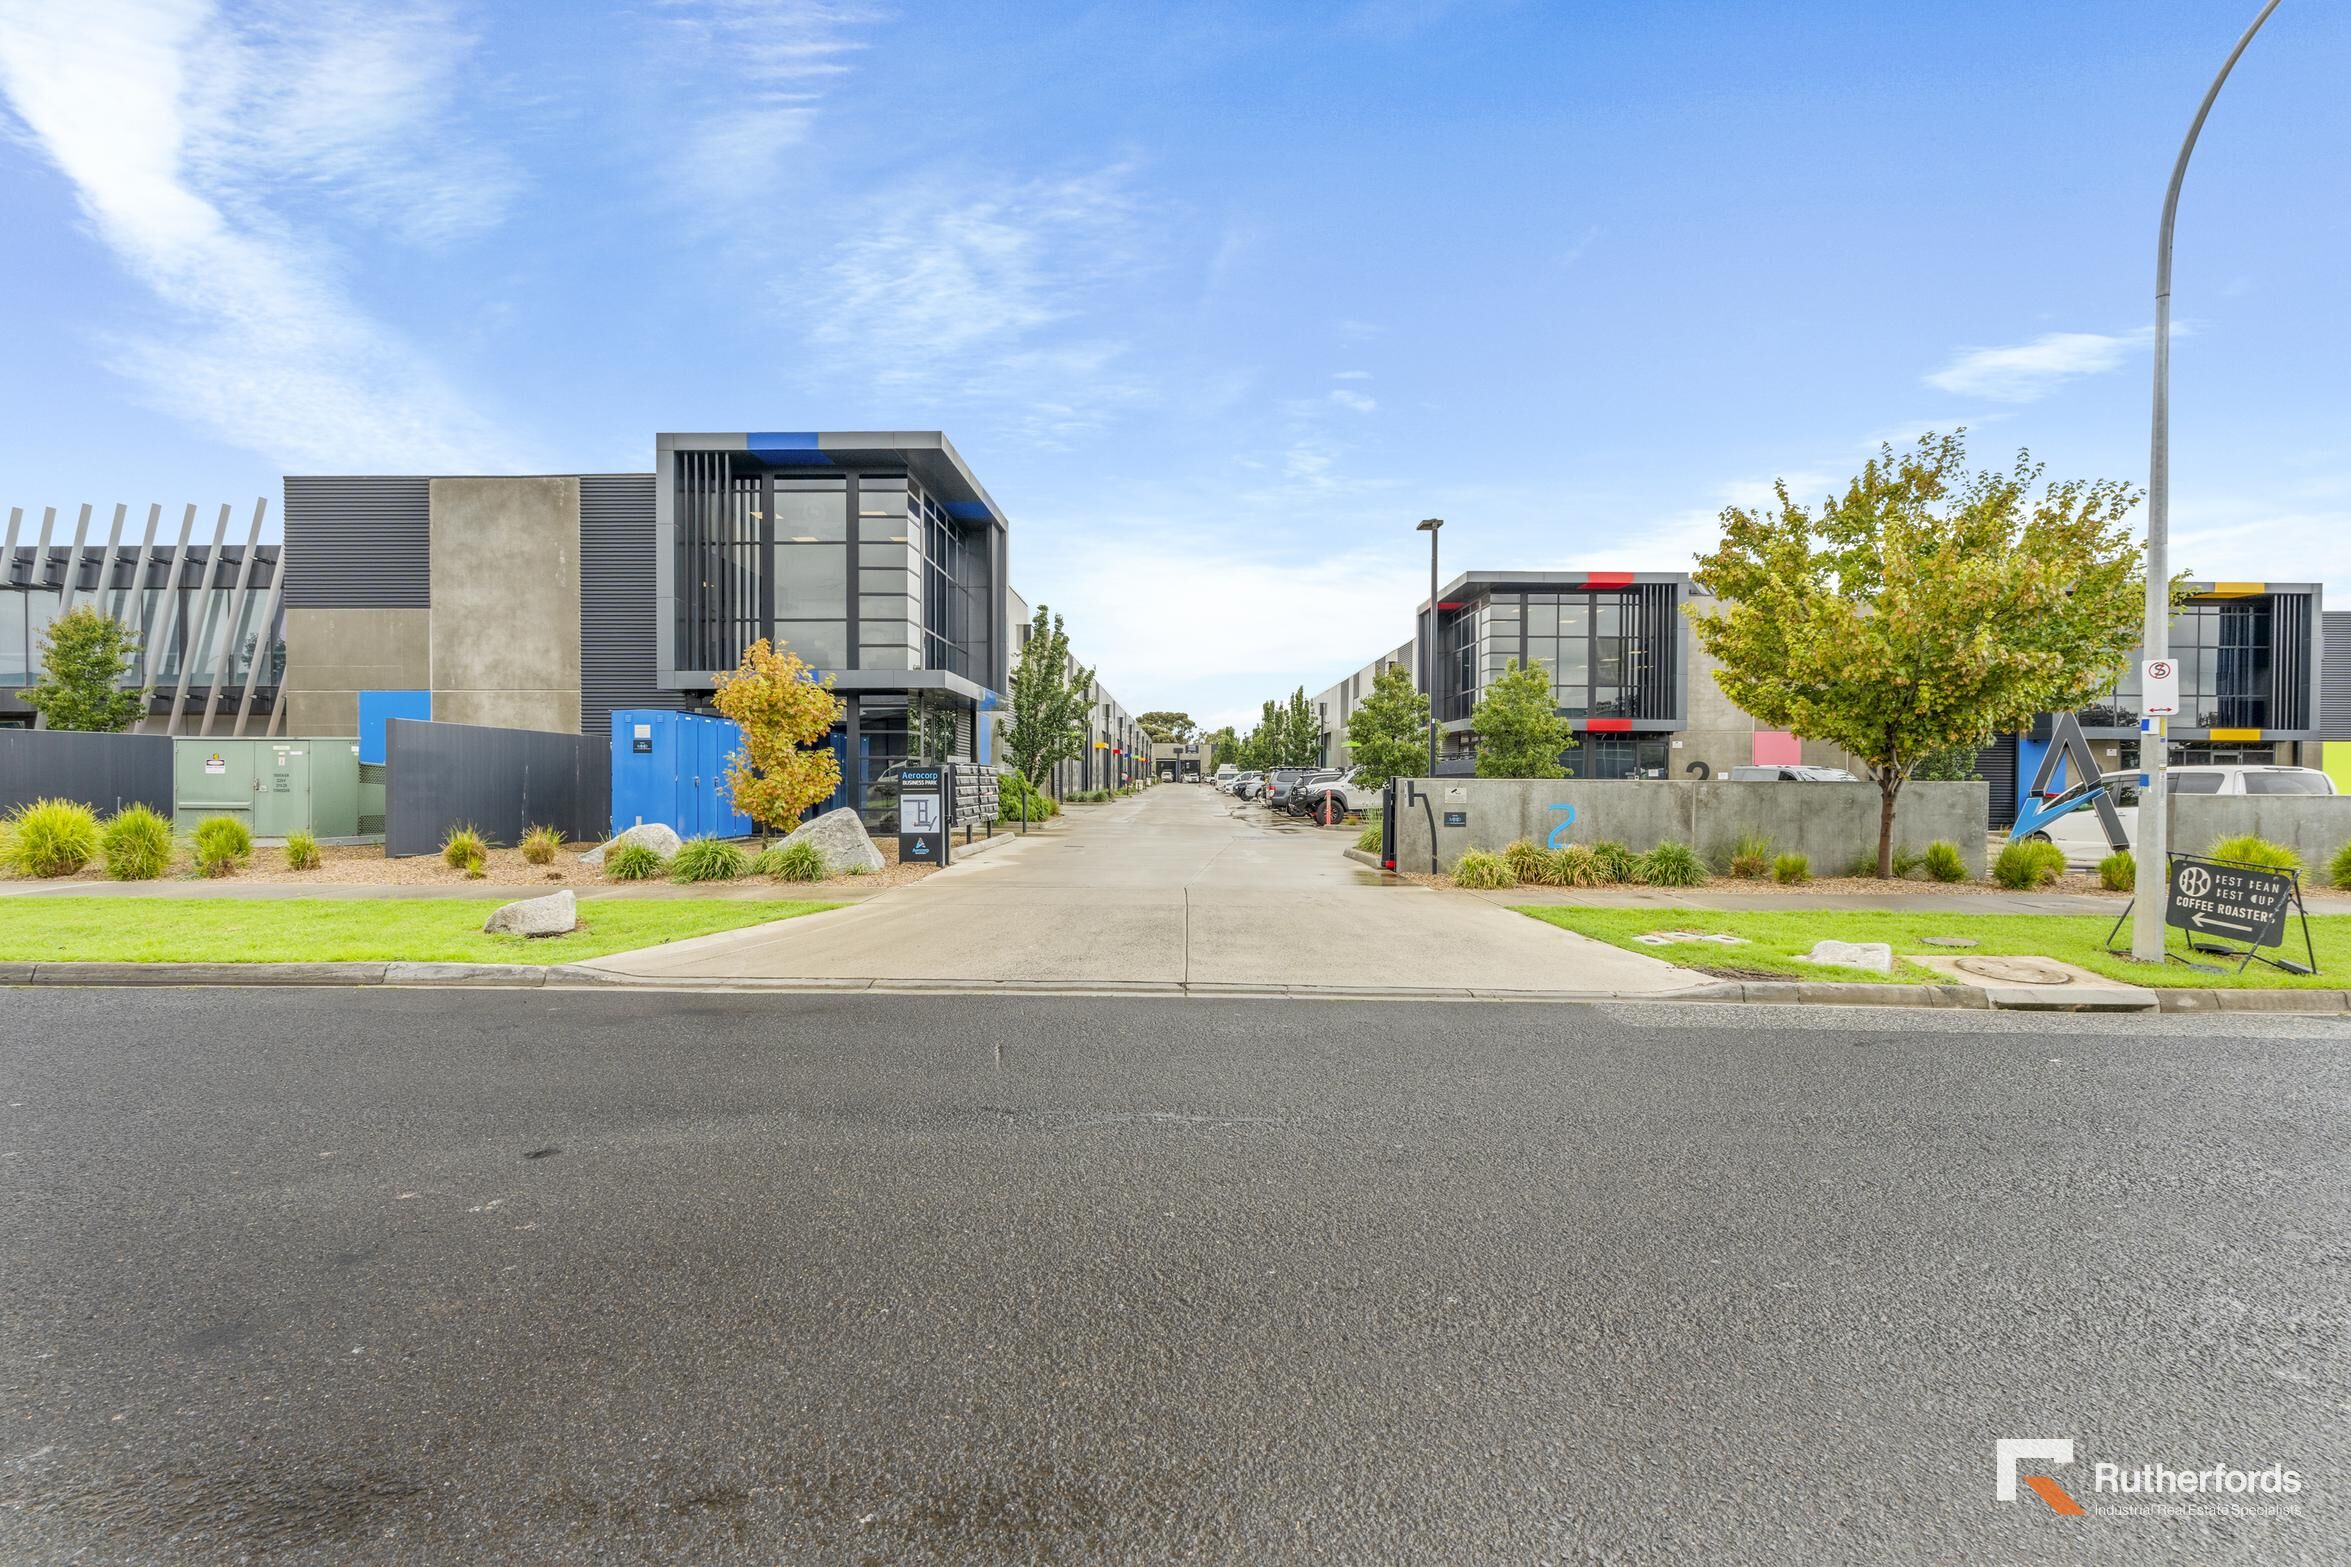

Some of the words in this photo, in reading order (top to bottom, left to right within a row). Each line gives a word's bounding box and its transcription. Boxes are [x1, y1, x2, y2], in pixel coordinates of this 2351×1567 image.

[902, 771, 938, 780] Aerocorp
[1548, 803, 1577, 849] 2
[2215, 874, 2243, 887] BEST
[2249, 880, 2280, 893] BEAN
[2216, 888, 2244, 901] BEST
[2250, 894, 2275, 906] CUP
[2176, 896, 2214, 912] COFFEE
[2217, 903, 2276, 924] ROASTERS
